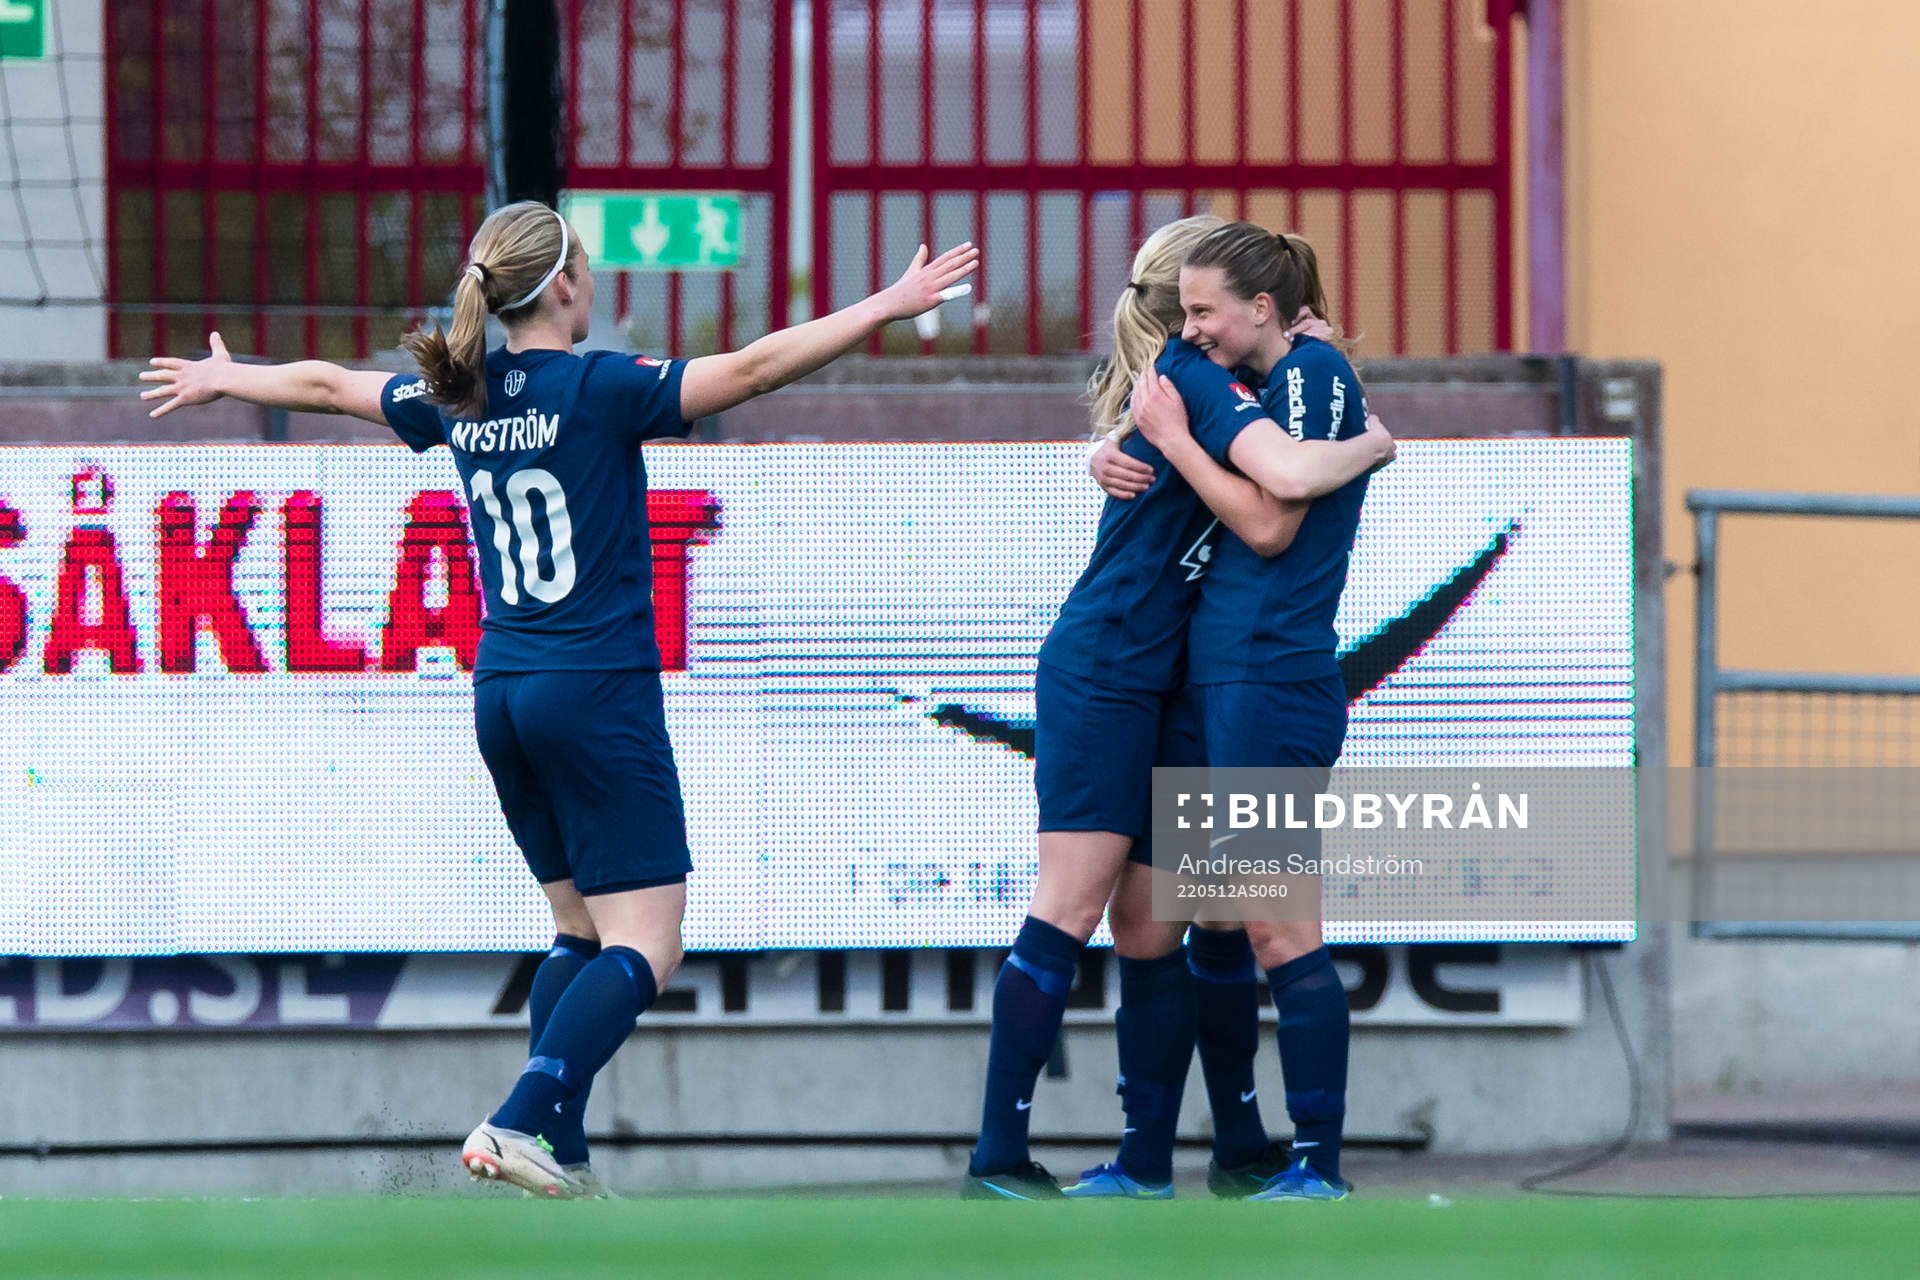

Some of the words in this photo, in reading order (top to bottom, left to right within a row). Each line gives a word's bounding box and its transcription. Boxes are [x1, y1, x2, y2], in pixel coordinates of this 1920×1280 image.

[451, 408, 560, 452] NYSTRÖM
[1327, 375, 1346, 440] tadium
[0, 466, 723, 674] ÅKLAT
[470, 467, 577, 606] 10
